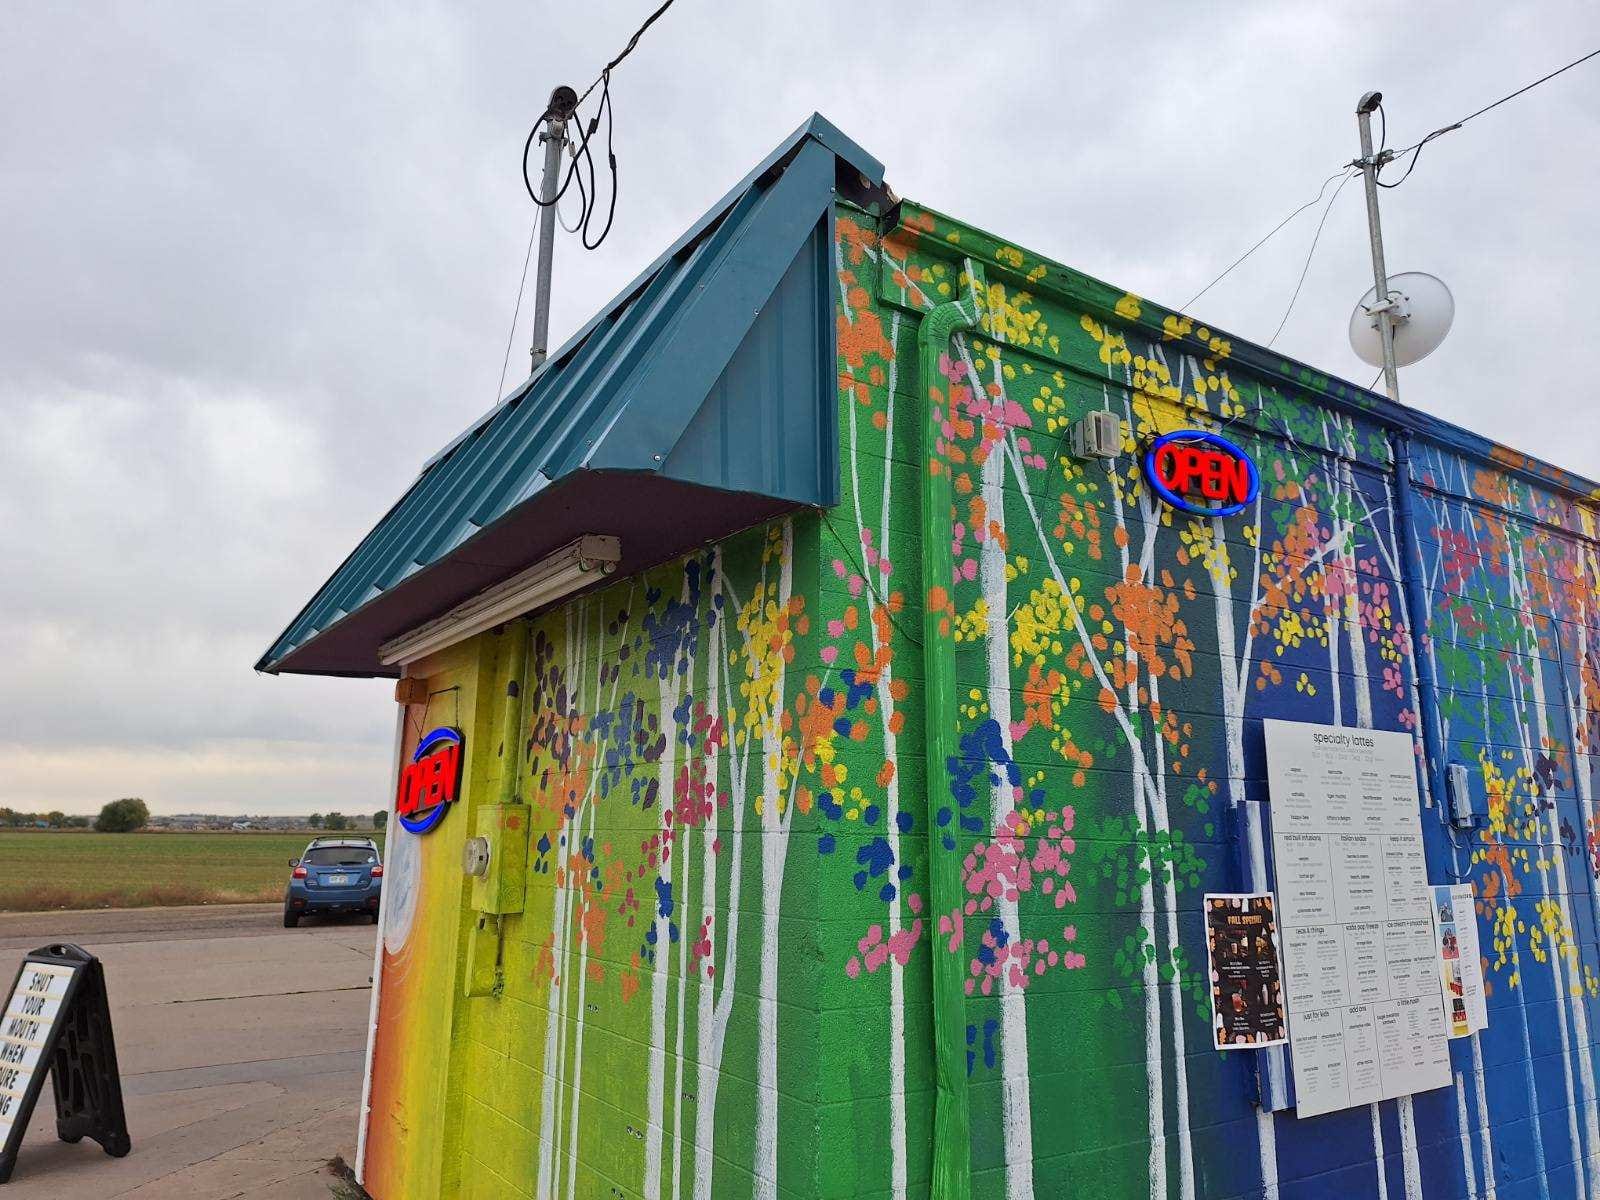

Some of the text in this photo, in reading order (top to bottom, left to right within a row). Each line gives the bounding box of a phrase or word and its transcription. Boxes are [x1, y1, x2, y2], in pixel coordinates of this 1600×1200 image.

[1154, 442, 1249, 503] OPEN
[1313, 733, 1375, 748] specialty lattes
[397, 743, 460, 816] OPEN
[1227, 915, 1241, 924] FALL
[29, 972, 54, 992] SHUT
[20, 997, 45, 1016] YOUR
[1303, 1013, 1312, 1021] just
[1320, 1010, 1330, 1018] kids
[1349, 1006, 1358, 1014] add
[8, 1018, 40, 1041] MOUTH
[0, 1043, 27, 1064] WHEN
